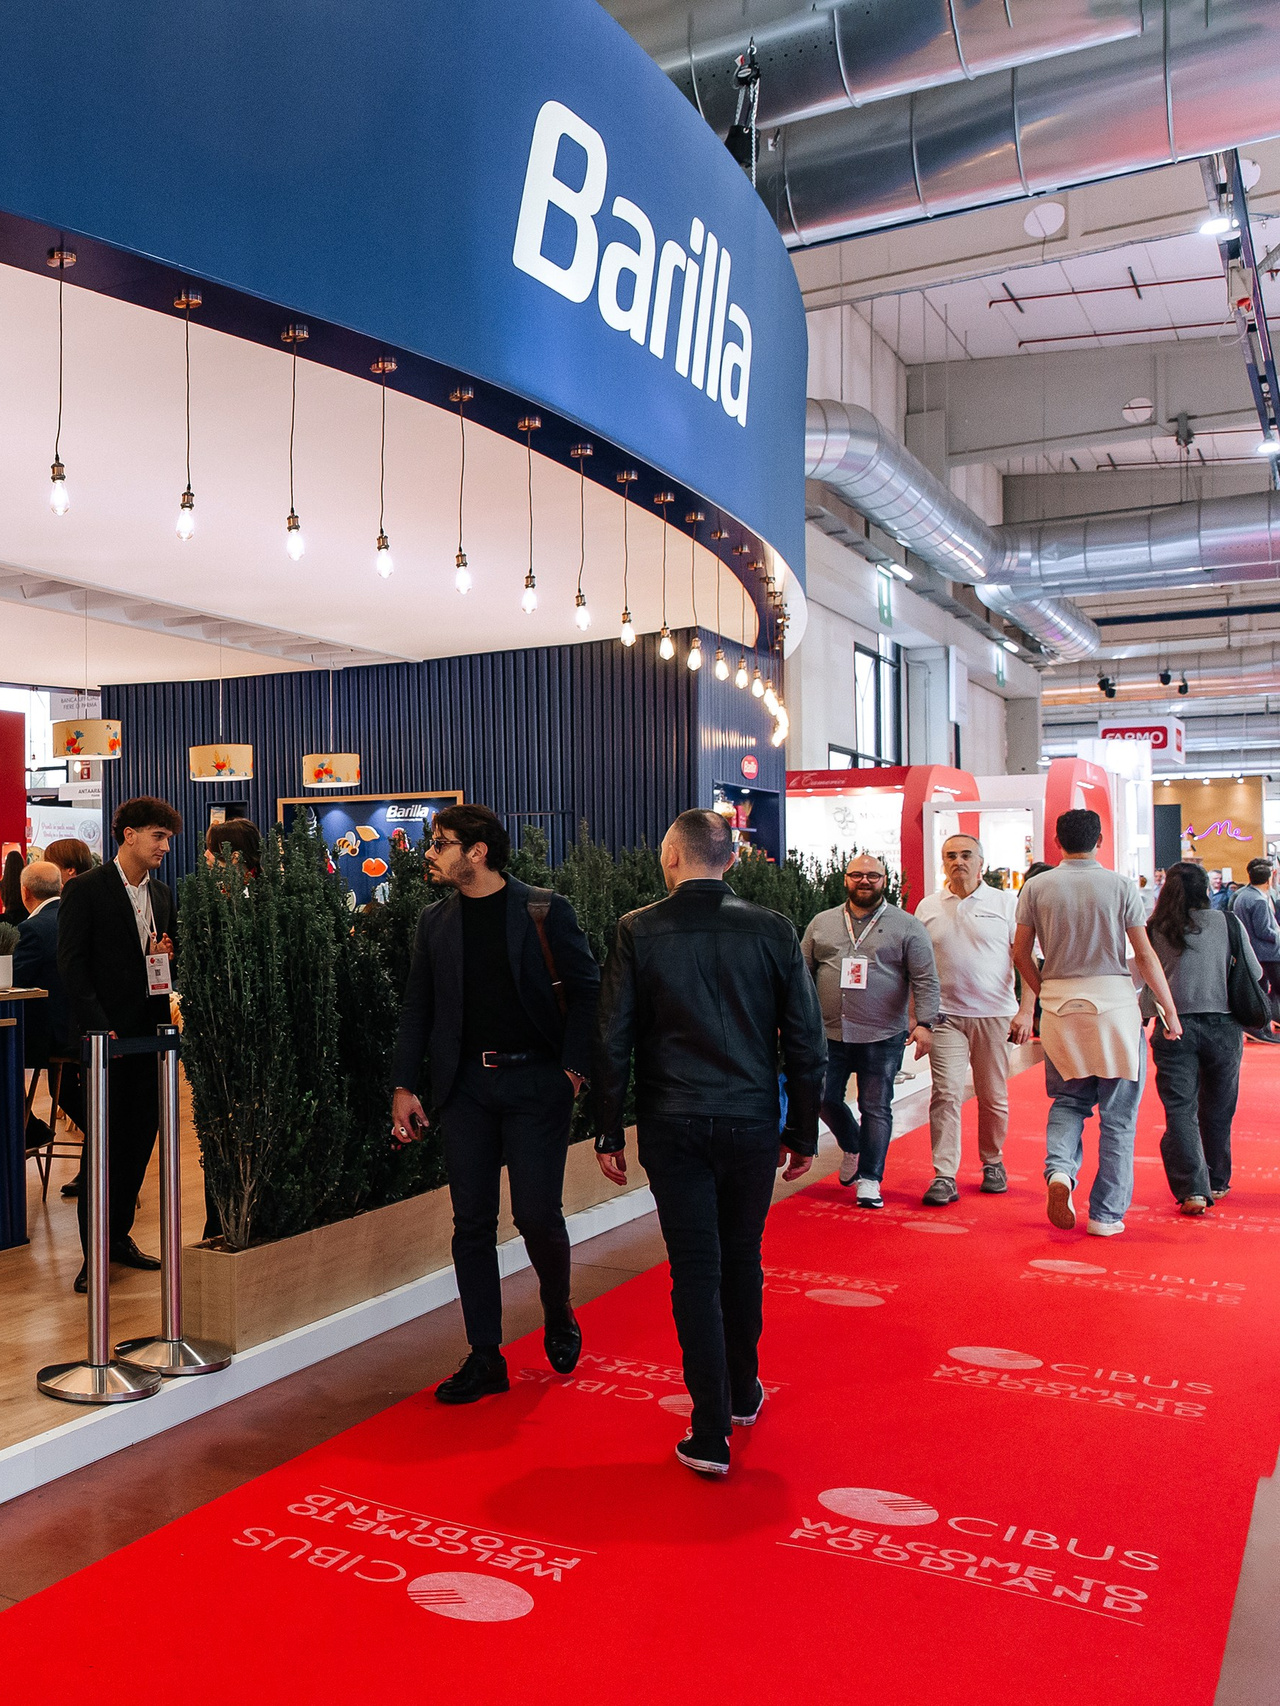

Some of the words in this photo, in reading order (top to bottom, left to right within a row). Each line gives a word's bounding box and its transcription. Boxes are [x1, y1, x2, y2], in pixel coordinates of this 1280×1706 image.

[512, 100, 753, 428] Barilla
[386, 804, 429, 819] Barilla
[1113, 1270, 1247, 1292] CIBUS
[932, 1370, 1205, 1418] FOODLAND
[938, 1363, 1138, 1400] WELCOME
[1150, 1396, 1208, 1411] TO
[1050, 1363, 1214, 1395] CIBUS
[286, 1503, 339, 1524] TO
[303, 1493, 582, 1570] FOODLAND
[232, 1526, 407, 1583] CIBUS
[346, 1518, 563, 1582] WELCOME
[788, 1528, 1144, 1614] FOODLAND
[800, 1516, 1058, 1583] WELCOME
[1072, 1574, 1150, 1601] TO
[947, 1516, 1160, 1572] CIBUS
